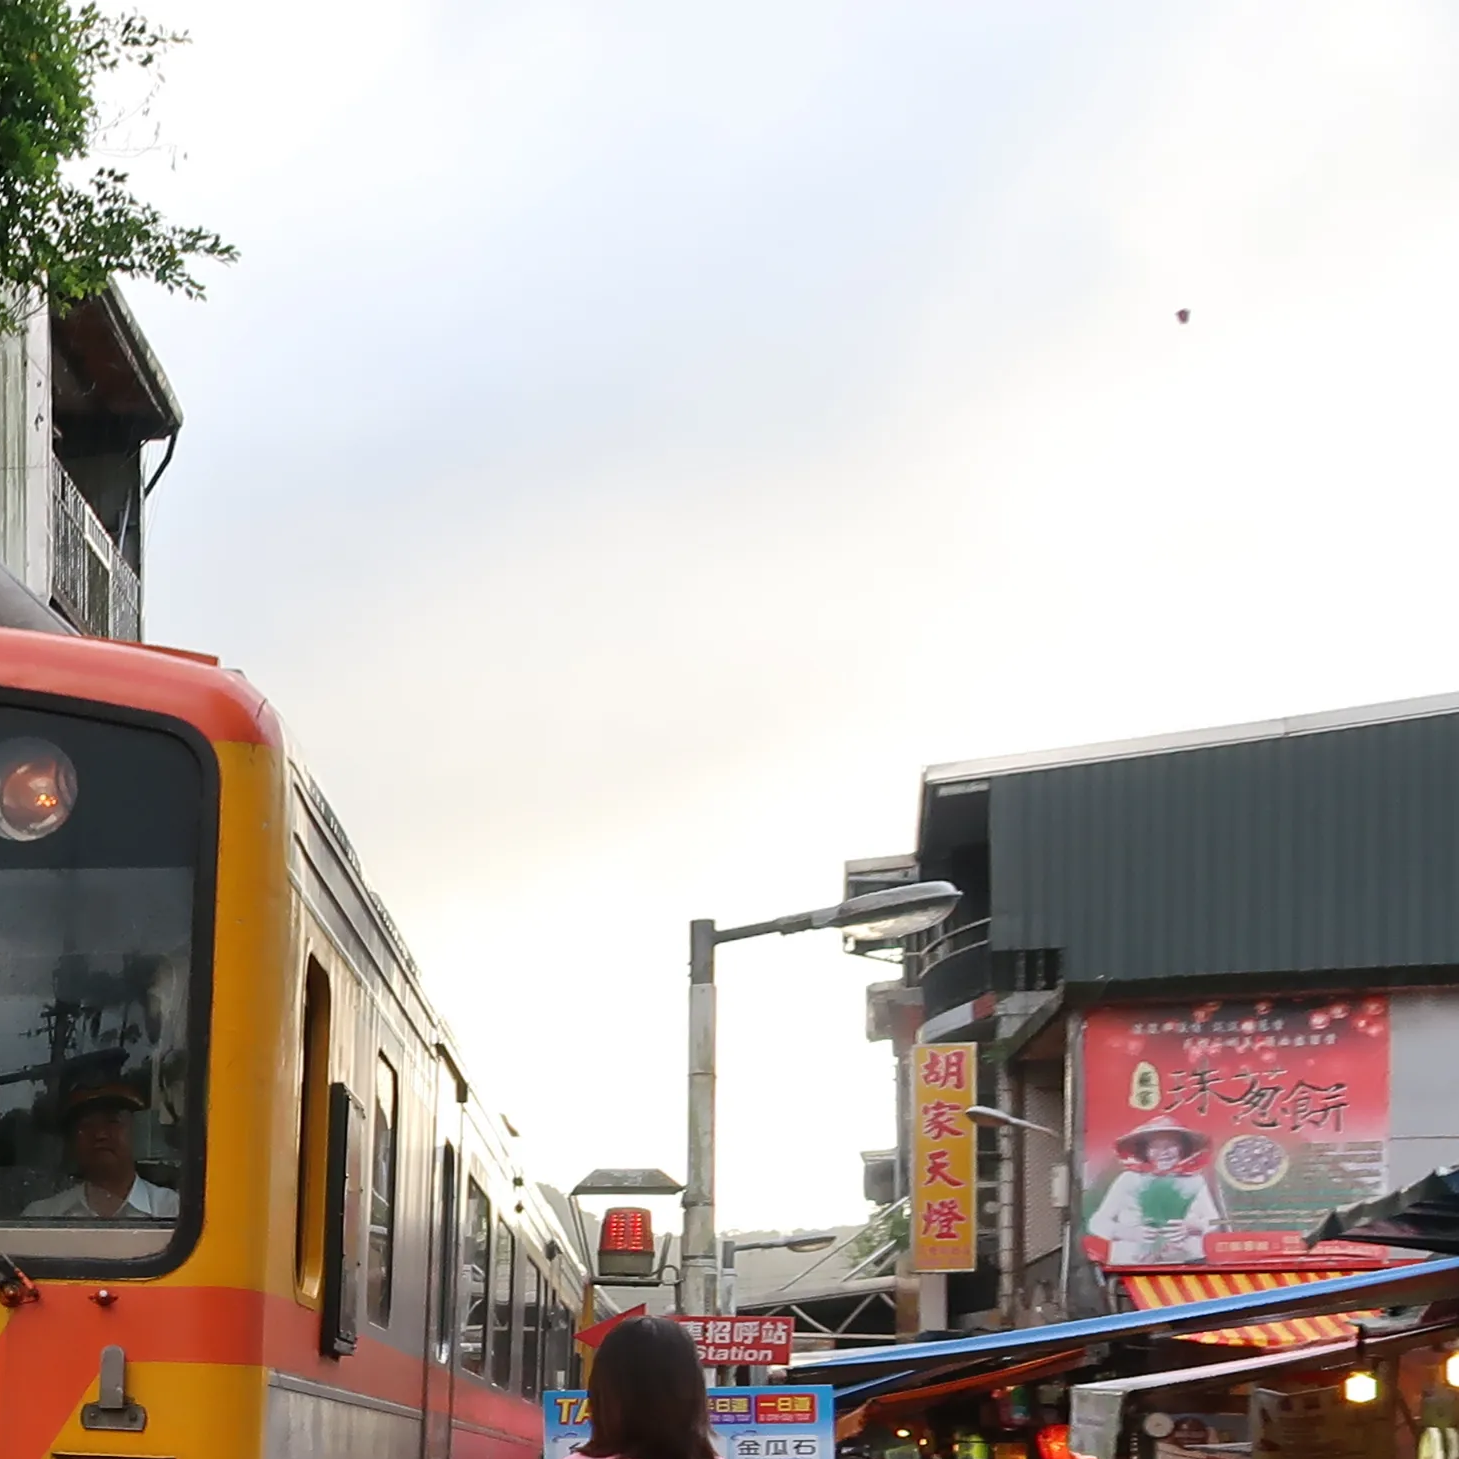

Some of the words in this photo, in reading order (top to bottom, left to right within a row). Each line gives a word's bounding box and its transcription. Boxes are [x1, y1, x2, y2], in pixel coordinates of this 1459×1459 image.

[921, 1050, 966, 1239] 胡家天燈
[697, 1346, 773, 1361] Station
[737, 1440, 817, 1455] 金瓜石
